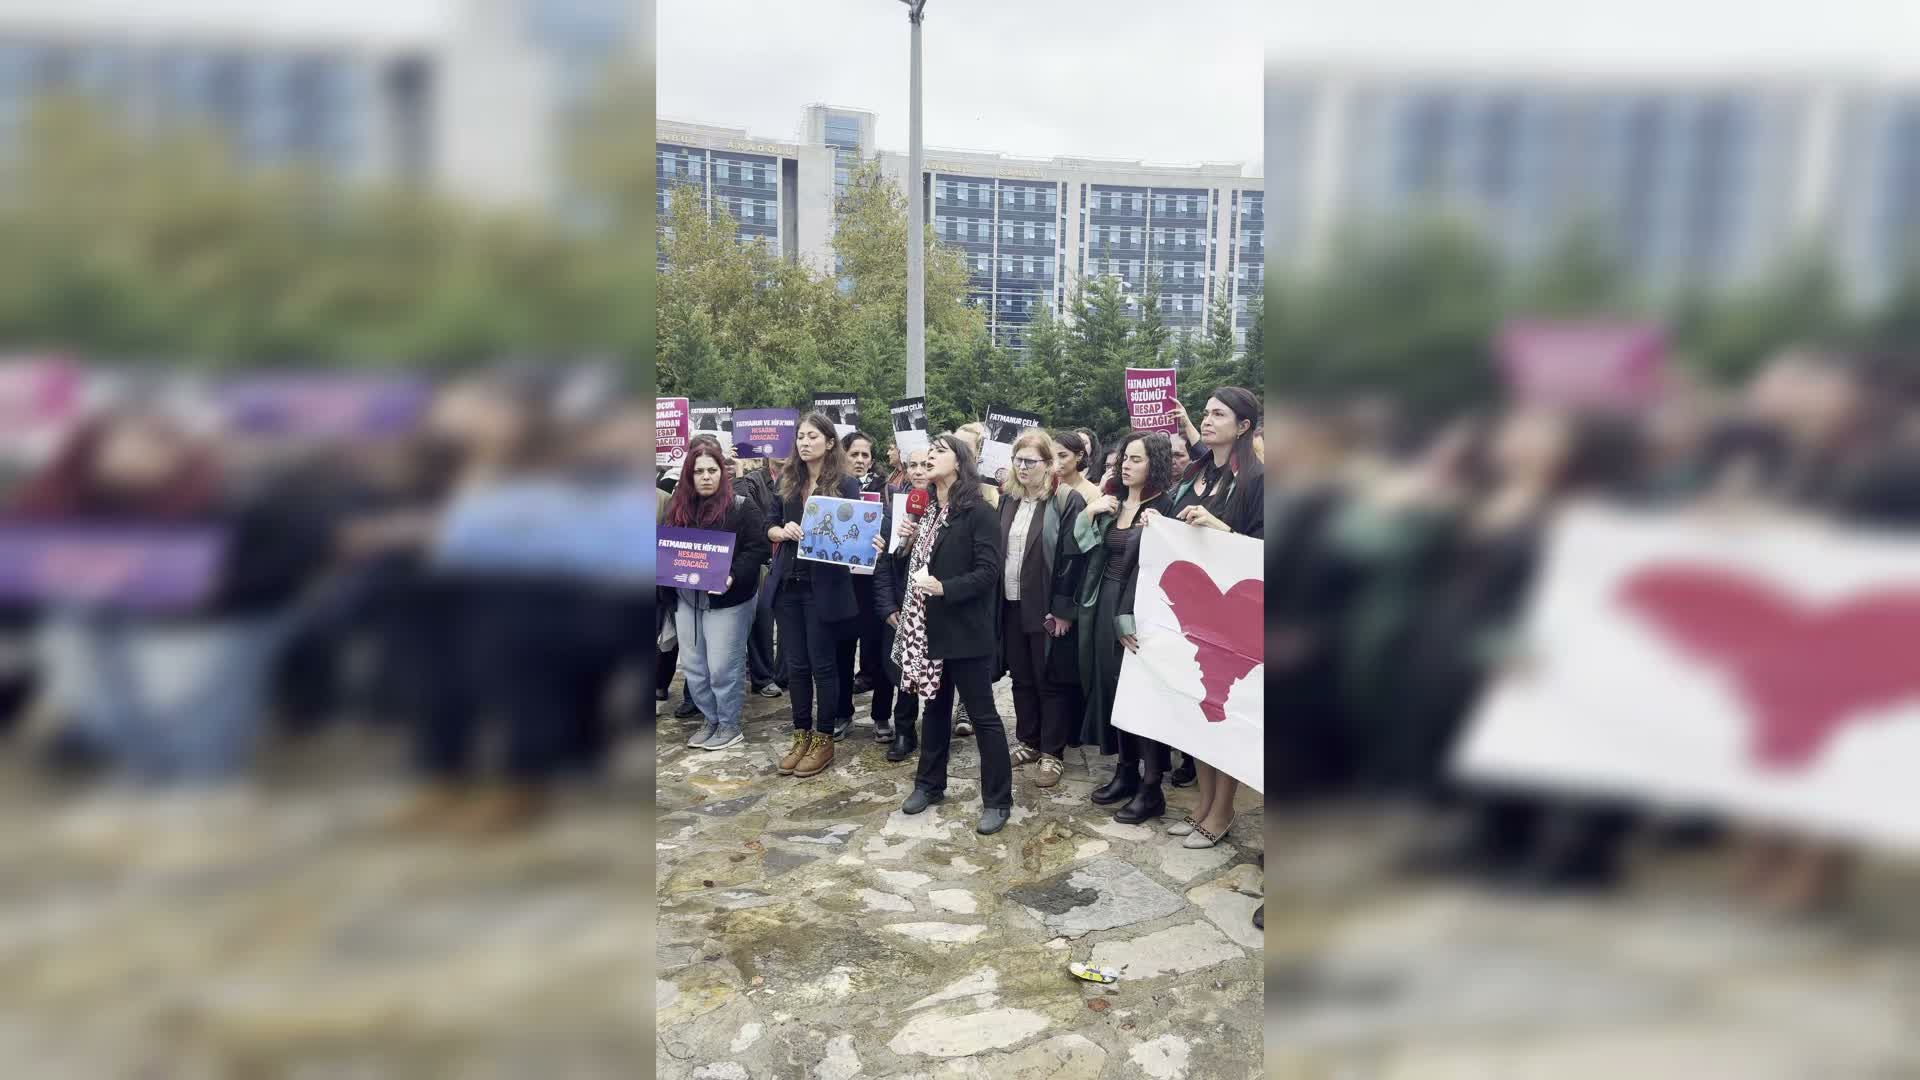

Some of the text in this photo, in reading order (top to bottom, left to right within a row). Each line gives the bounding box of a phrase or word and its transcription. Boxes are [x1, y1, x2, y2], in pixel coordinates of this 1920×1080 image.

[1127, 376, 1172, 389] FATMANURA
[1130, 388, 1168, 402] SÖZÜMÜZ
[1134, 403, 1162, 415] HESAP
[990, 413, 1040, 428] FATMANUR ÇELİK
[656, 429, 675, 437] ESAP
[658, 539, 729, 554] FATMANUR VE HİFA'NIN
[677, 550, 707, 560] HESABINI
[673, 559, 709, 569] SORACAĞIZ
